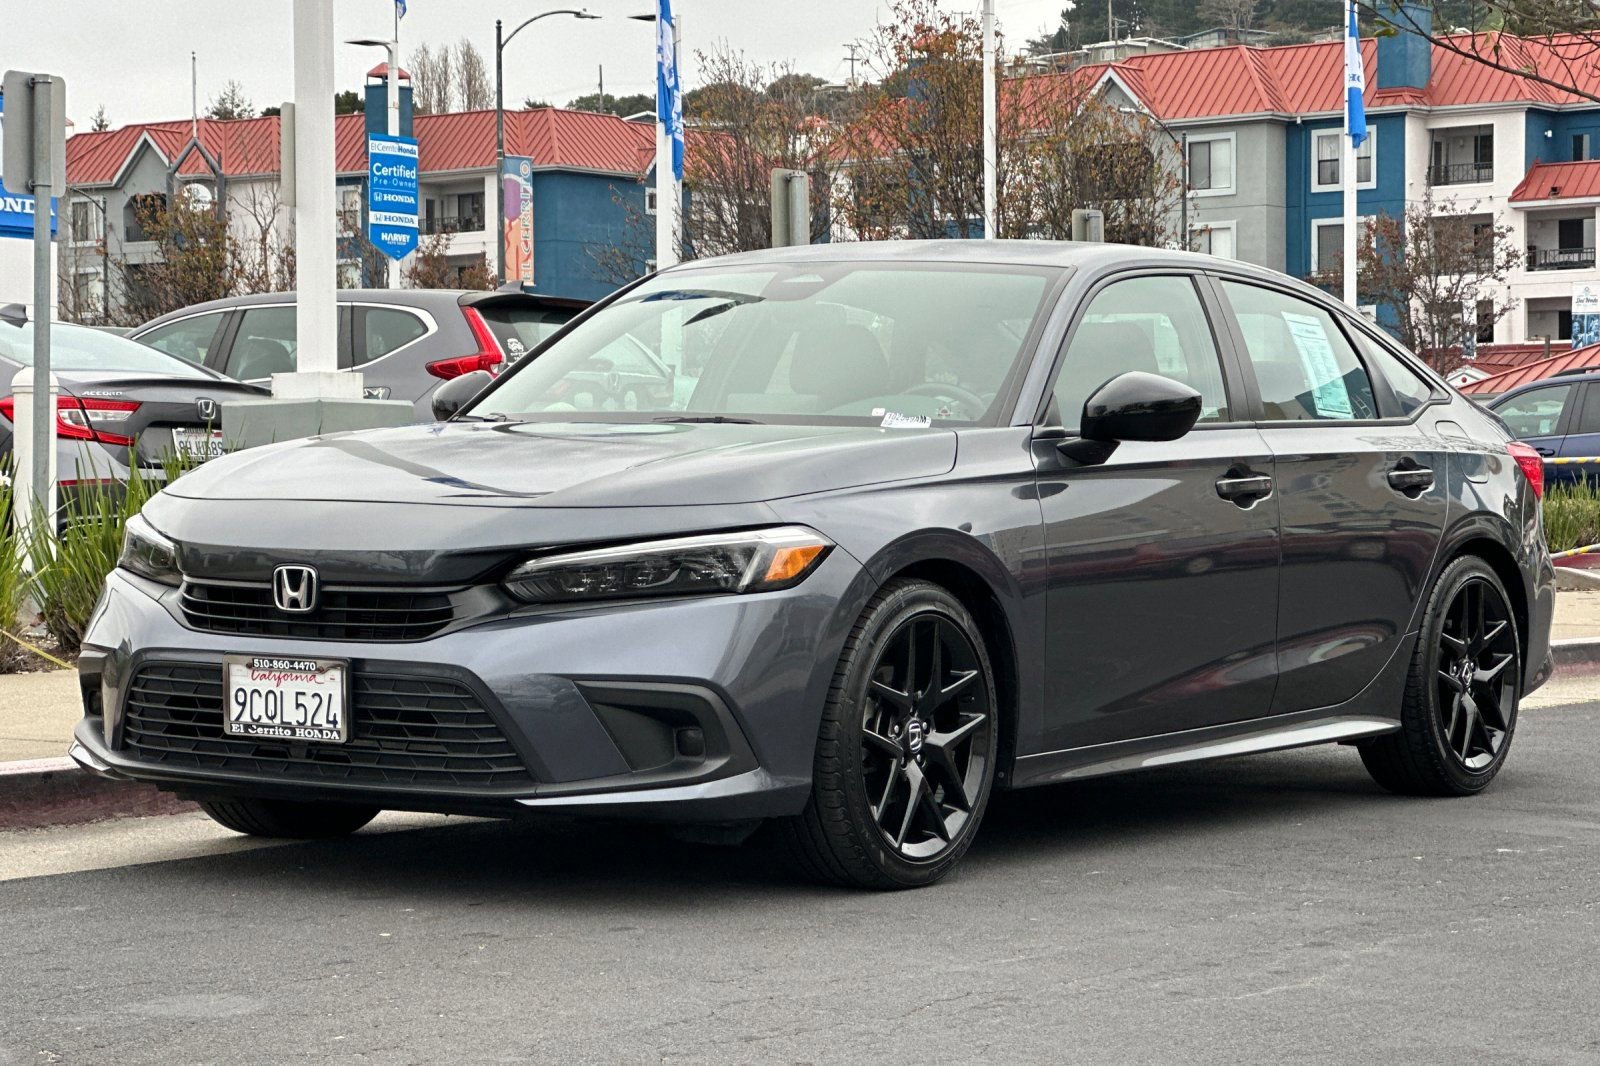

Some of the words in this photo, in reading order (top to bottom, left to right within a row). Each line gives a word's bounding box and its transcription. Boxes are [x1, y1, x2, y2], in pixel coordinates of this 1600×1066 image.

[373, 162, 416, 179] Certified
[383, 193, 416, 204] HONDA
[383, 214, 415, 224] HONDA
[381, 232, 410, 243] HARVEY
[254, 659, 316, 670] 510-860-4470
[251, 669, 324, 687] California
[234, 687, 339, 729] 9CQL524
[231, 723, 245, 733] El
[248, 726, 292, 735] Cerrito
[296, 729, 339, 740] HONDA
